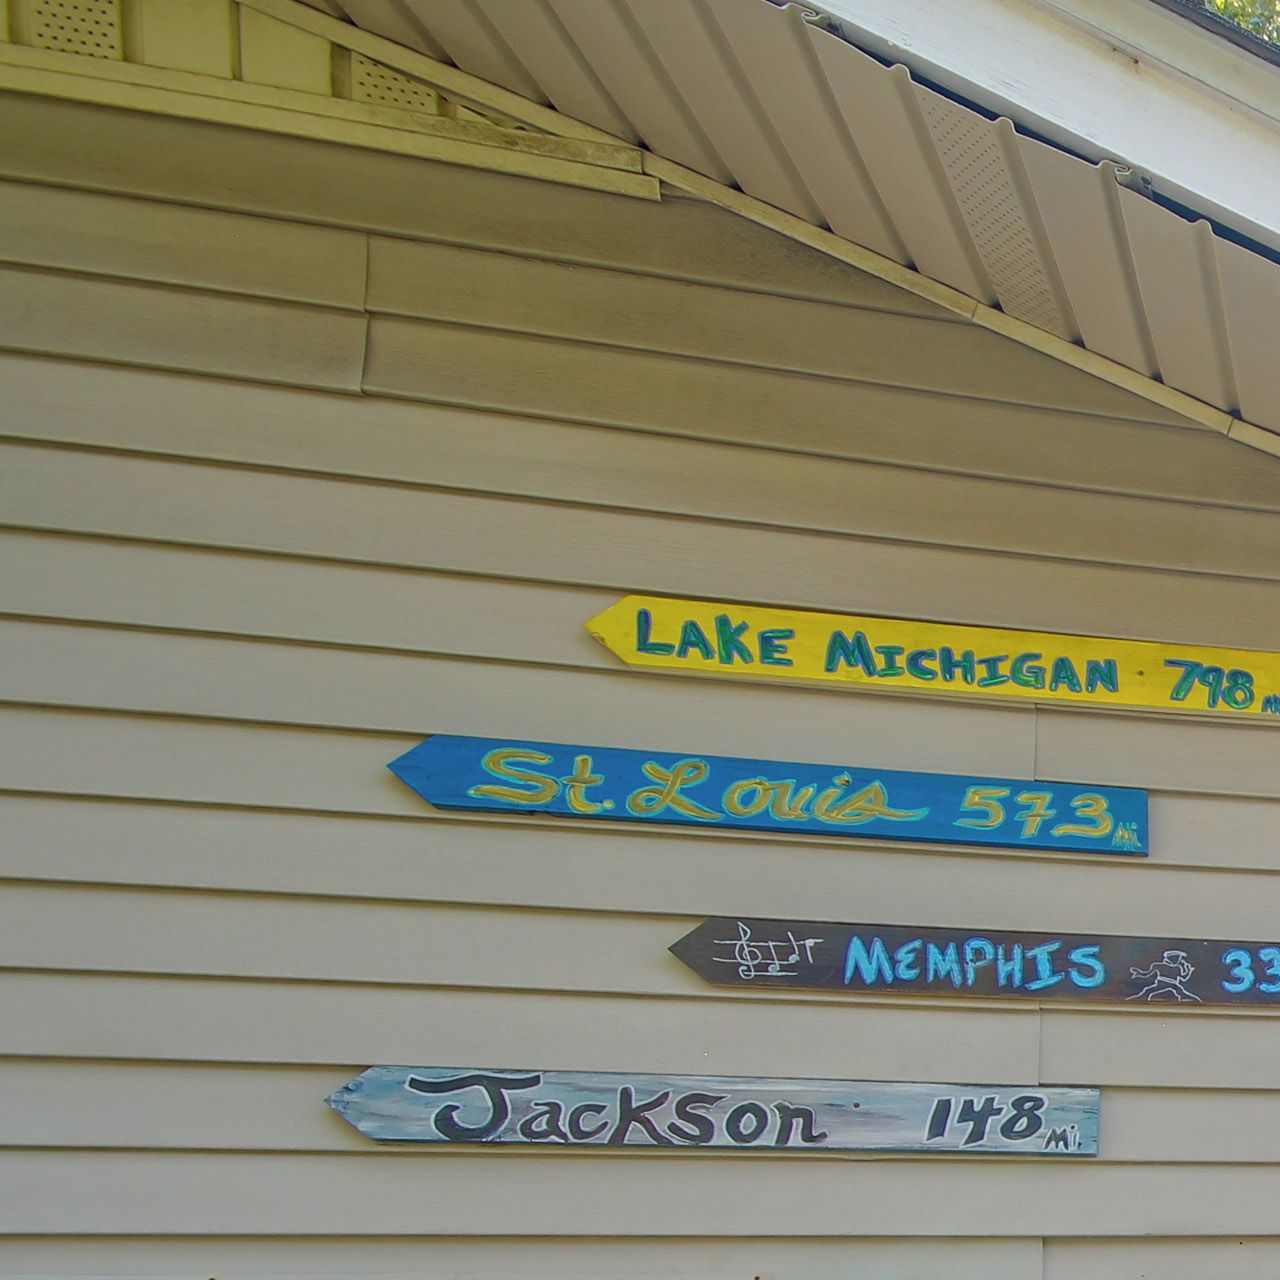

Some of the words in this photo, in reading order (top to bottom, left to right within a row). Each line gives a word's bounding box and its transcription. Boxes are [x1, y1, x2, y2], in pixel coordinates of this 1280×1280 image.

[636, 609, 795, 666] LAKE
[825, 630, 1118, 693] MICHIGAN
[1164, 657, 1256, 710] 798
[466, 747, 614, 815] St.
[625, 758, 930, 823] Louis
[953, 786, 1113, 839] 573
[842, 935, 1107, 991] MEMPHIS
[403, 1072, 833, 1146] Jackson
[922, 1093, 1049, 1150] 148
